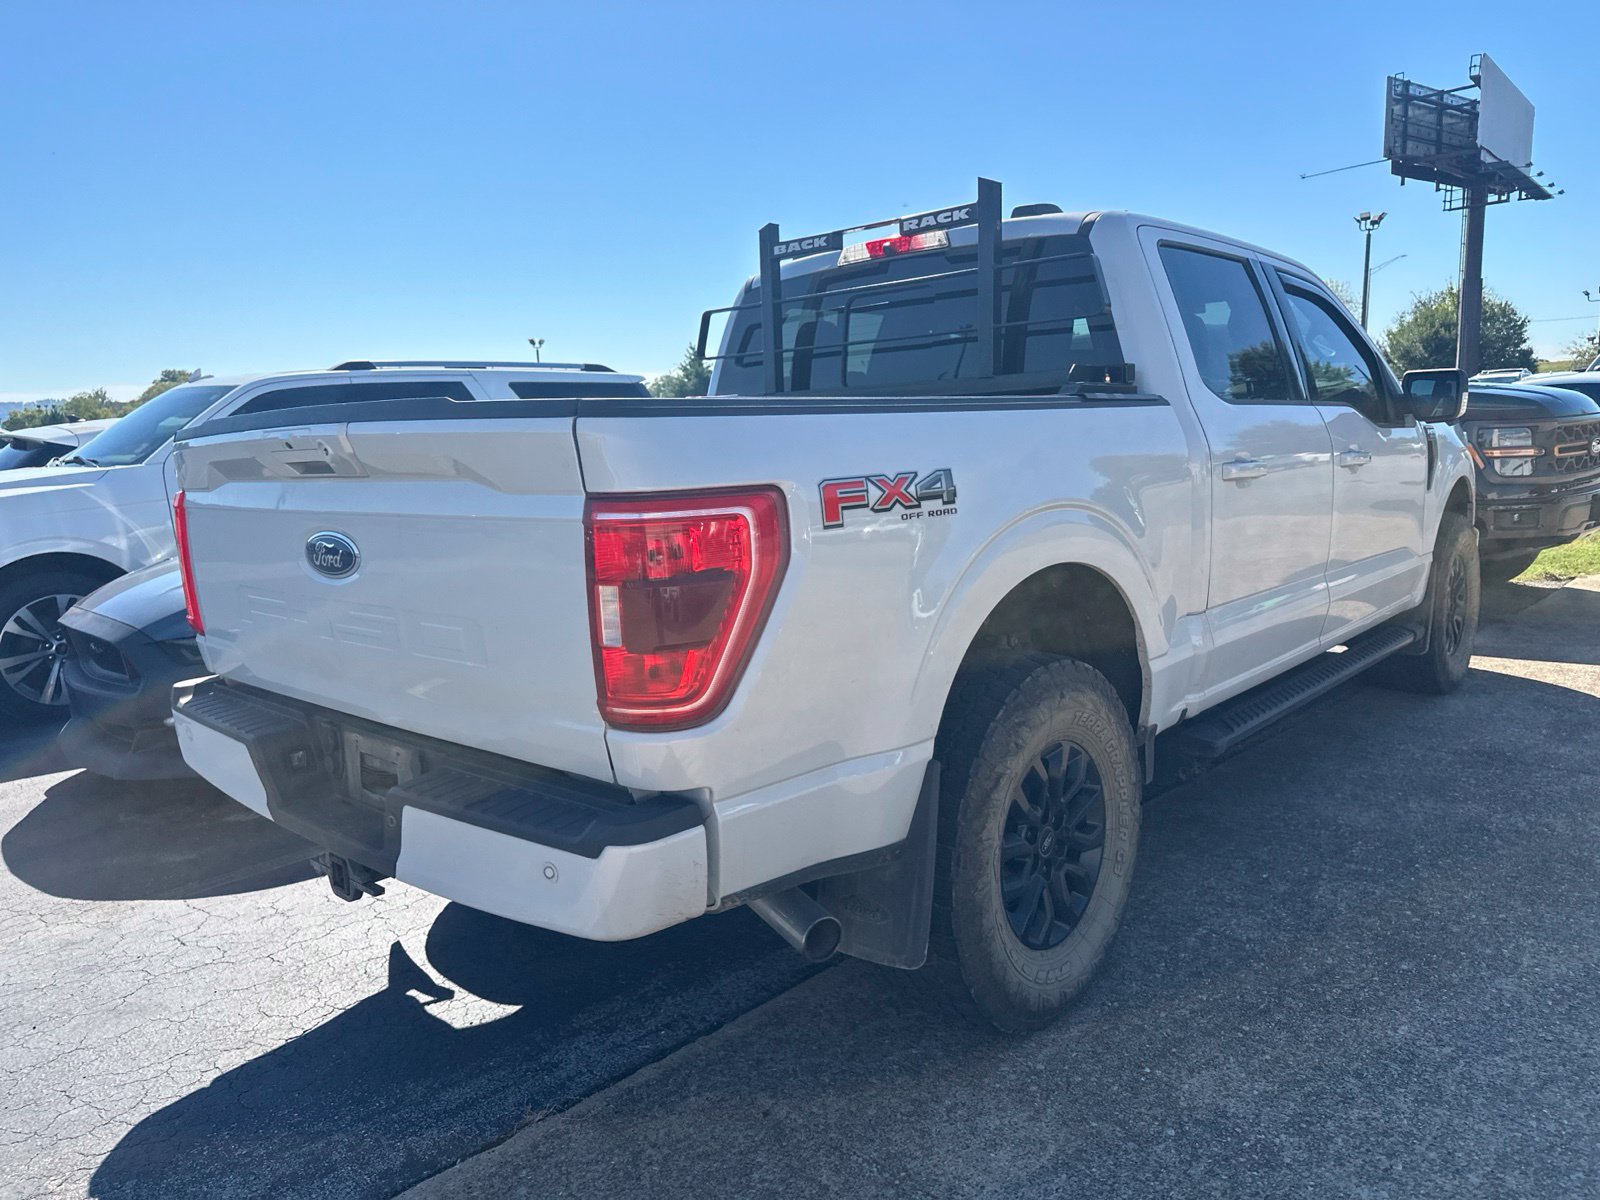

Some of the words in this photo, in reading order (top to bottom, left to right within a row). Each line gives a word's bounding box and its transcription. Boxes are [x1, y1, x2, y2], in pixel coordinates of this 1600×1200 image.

[773, 236, 827, 256] BACK
[903, 208, 970, 231] RACK
[818, 468, 957, 530] FX4
[901, 511, 924, 521] OFF
[927, 507, 958, 517] ROAD
[313, 540, 343, 568] Ford
[1072, 711, 1107, 742] TERRA
[1104, 738, 1130, 842] GRAPPLER
